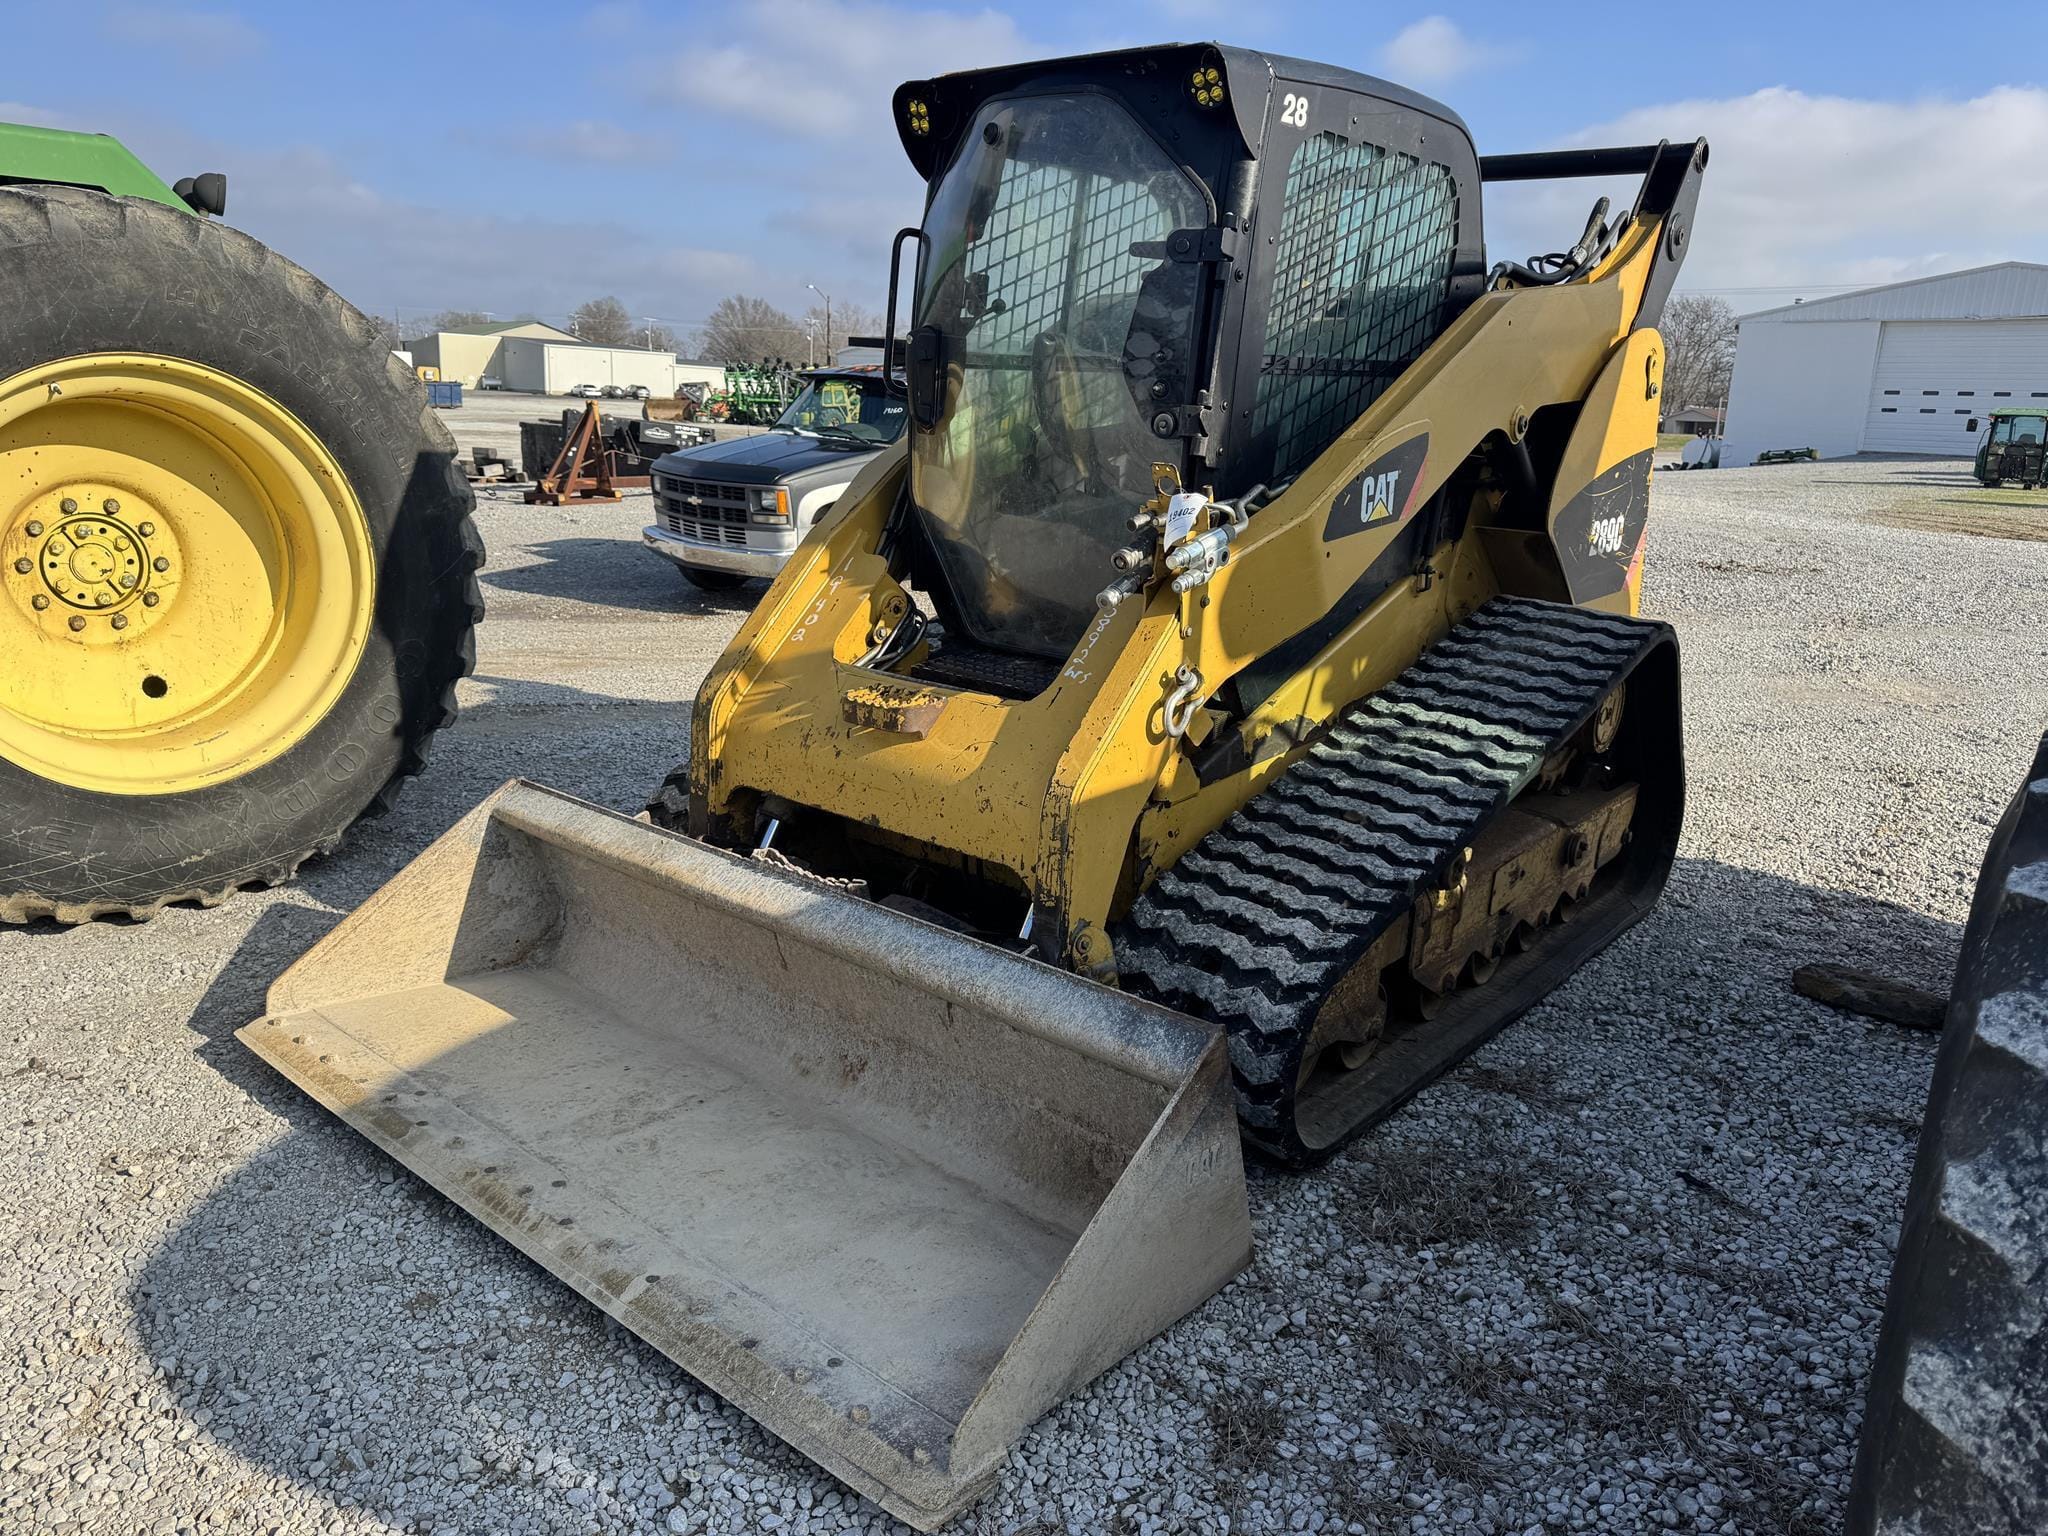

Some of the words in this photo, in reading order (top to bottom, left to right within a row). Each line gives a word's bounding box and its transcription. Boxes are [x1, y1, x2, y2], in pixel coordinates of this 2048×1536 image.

[1281, 93, 1309, 128] 28
[1361, 470, 1399, 523] CAT
[1168, 507, 1196, 523] 19402
